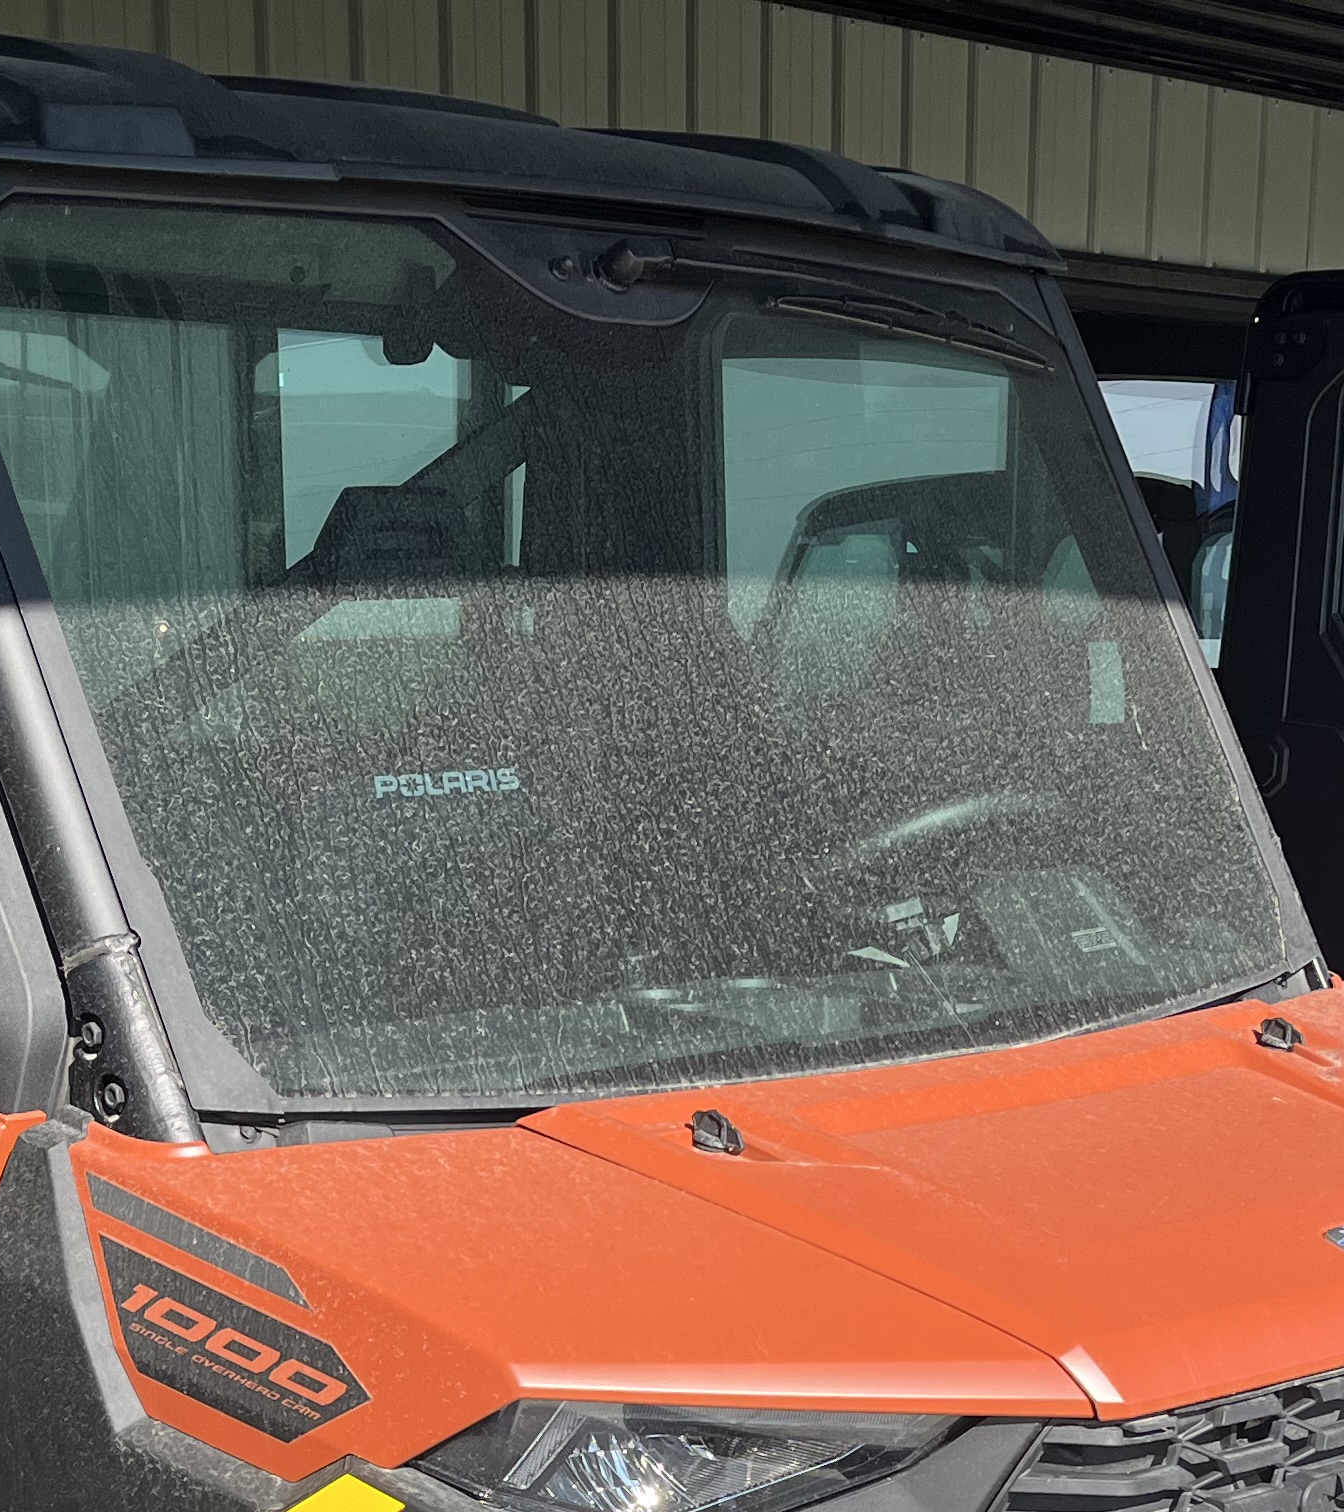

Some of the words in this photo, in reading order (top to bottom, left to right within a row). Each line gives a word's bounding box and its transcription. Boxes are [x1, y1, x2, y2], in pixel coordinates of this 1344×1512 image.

[374, 767, 520, 799] POLARIS
[121, 1284, 348, 1406] 1000
[129, 1322, 188, 1357] SINGLE
[191, 1354, 281, 1402] OVERHEAD
[281, 1397, 322, 1421] CAM
